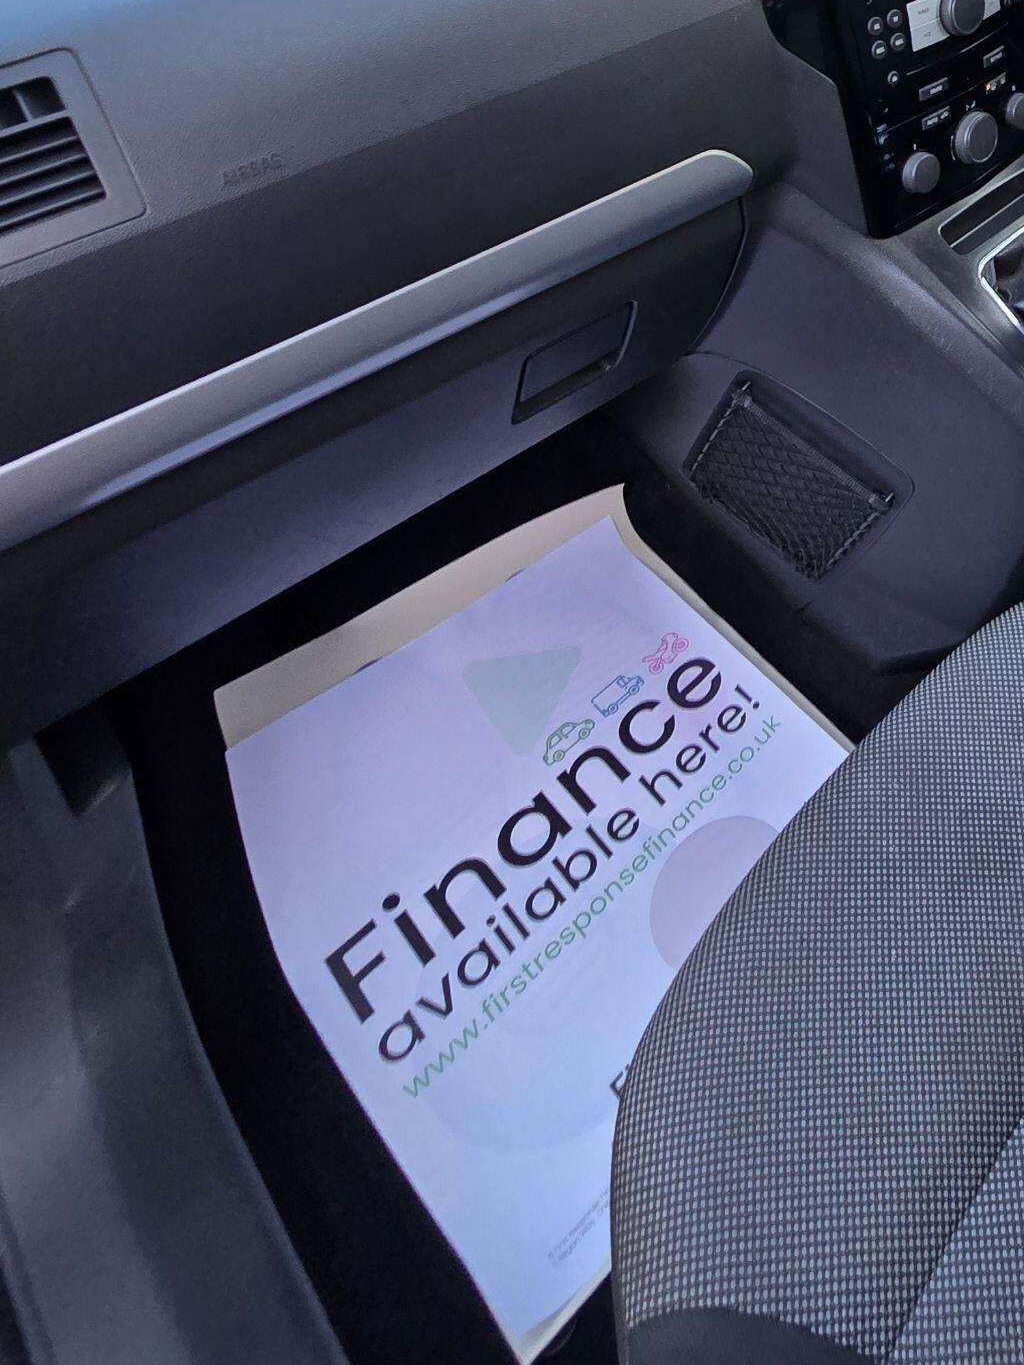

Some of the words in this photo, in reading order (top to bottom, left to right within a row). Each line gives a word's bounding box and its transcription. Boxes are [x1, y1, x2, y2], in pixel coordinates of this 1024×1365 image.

[325, 657, 722, 1025] Finance
[378, 807, 640, 1062] available
[638, 684, 760, 807] here!
[402, 715, 781, 1098] www.firstresponsefinance.co.uk
